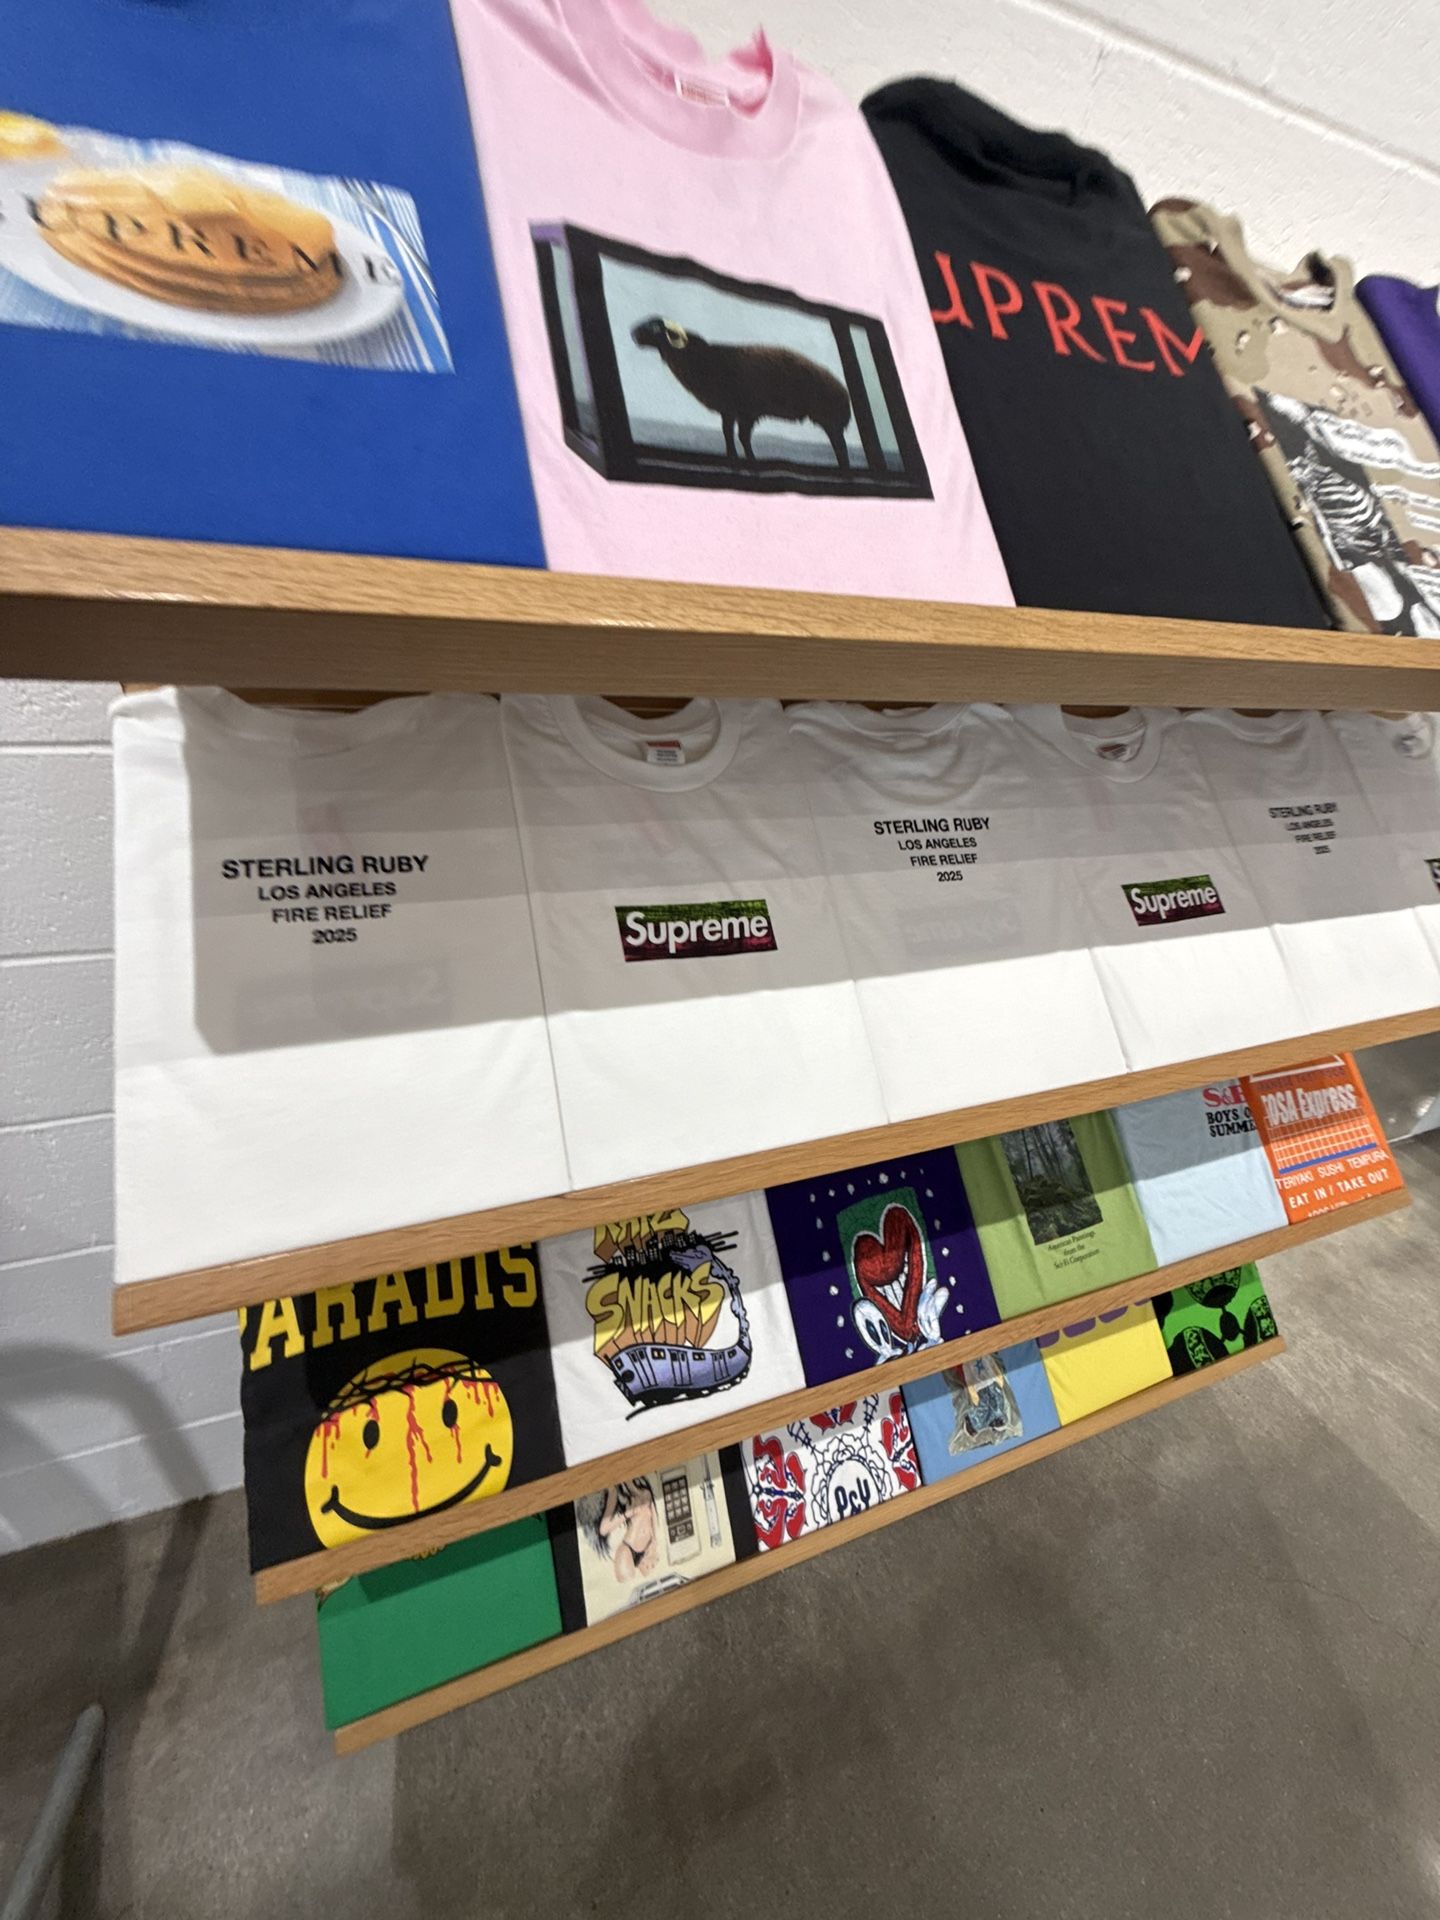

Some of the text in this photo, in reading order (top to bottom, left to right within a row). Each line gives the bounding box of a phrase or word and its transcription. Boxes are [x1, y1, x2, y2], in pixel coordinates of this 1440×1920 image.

[0, 190, 401, 287] UPREME
[873, 817, 990, 835] STERLING RUBY
[898, 837, 978, 851] LOS ANGELES
[221, 854, 429, 879] STERLING RUBY
[910, 853, 978, 867] FIRE RELIEF
[937, 870, 963, 882] 2025
[257, 881, 398, 901] LOS ANGELES
[1130, 886, 1218, 920] Supreme
[272, 903, 393, 924] FIRE RELIEF
[311, 927, 358, 944] 2025
[625, 911, 769, 954] Supreme
[1296, 1083, 1358, 1119] Express
[1205, 1108, 1240, 1125] BOYS
[1319, 1161, 1346, 1178] SUSHI
[1288, 1191, 1310, 1209] EAT
[1314, 1185, 1328, 1201] IN
[1336, 1174, 1367, 1193] TAKE
[1370, 1167, 1391, 1185] OUT
[586, 1261, 726, 1356] SNACKS
